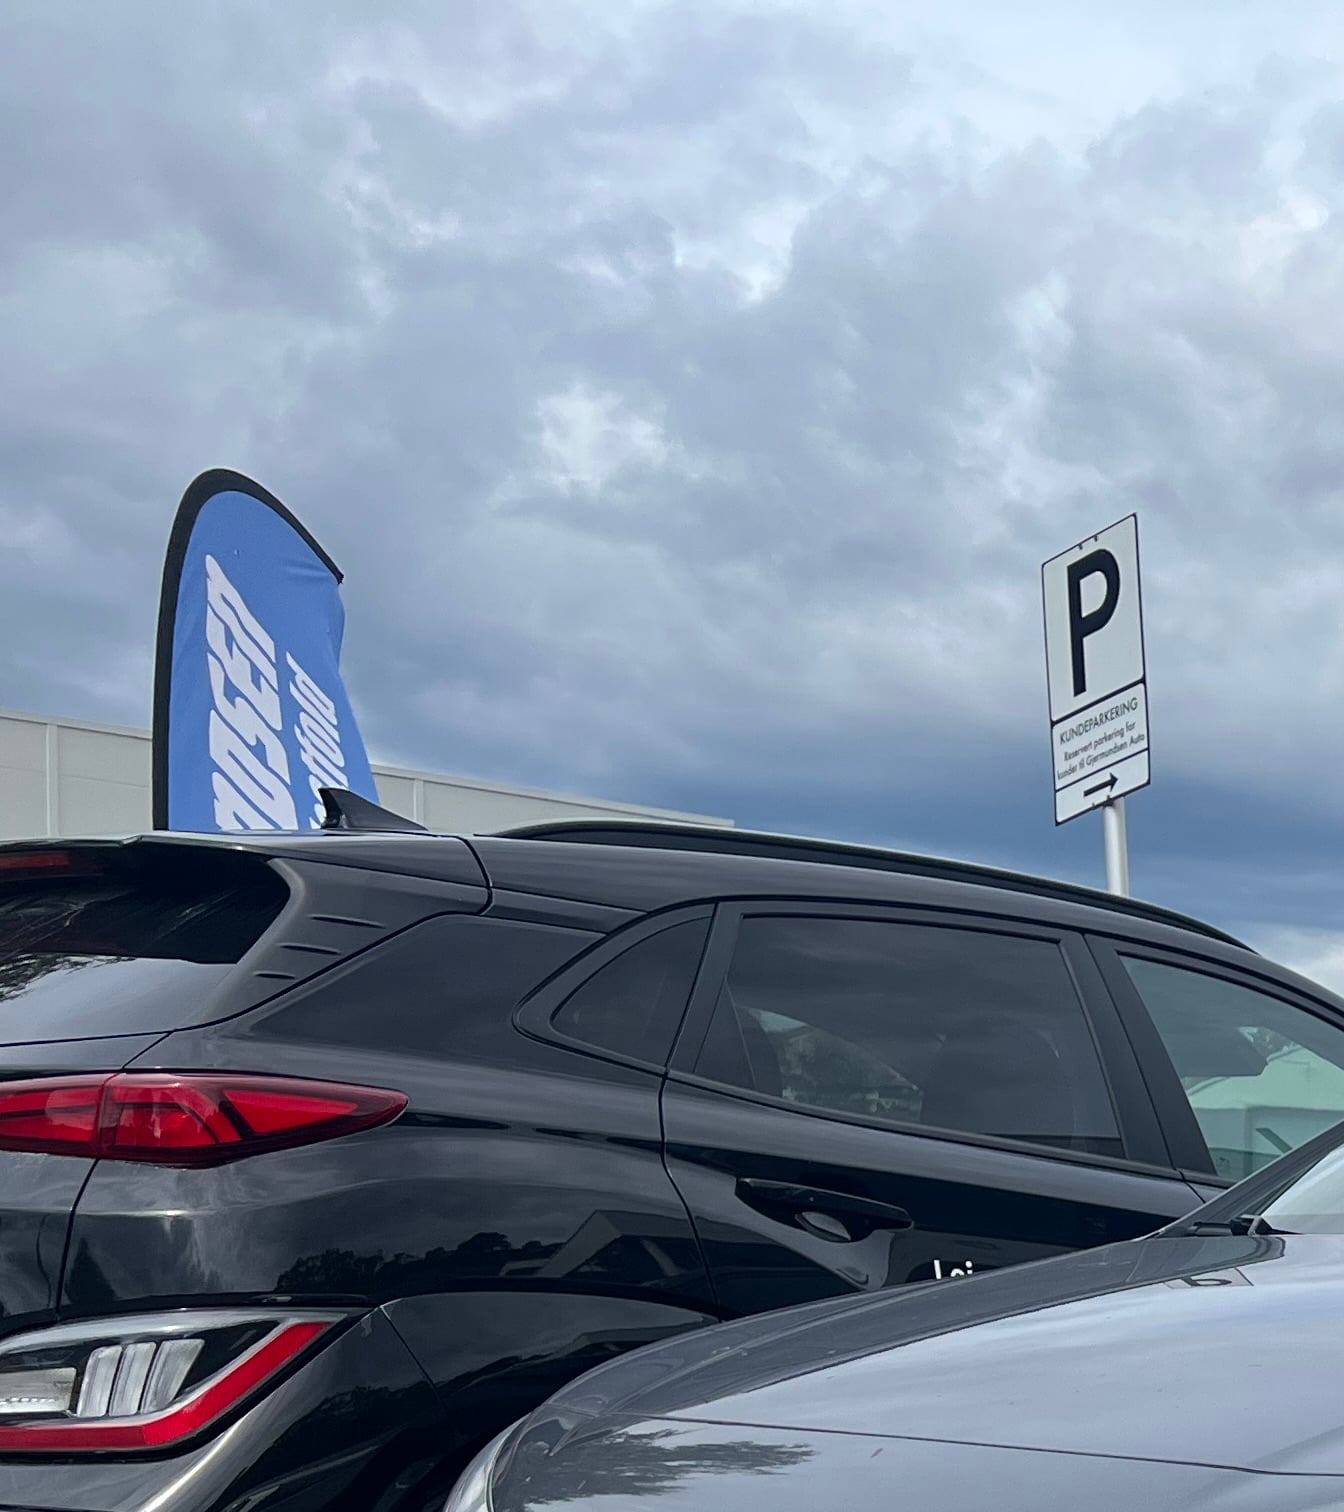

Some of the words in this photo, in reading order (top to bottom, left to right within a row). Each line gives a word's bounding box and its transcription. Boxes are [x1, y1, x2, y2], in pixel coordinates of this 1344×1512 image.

[1067, 548, 1120, 698] P
[1060, 697, 1138, 745] KUNDEPARKERING
[1094, 728, 1125, 750] parkering
[1126, 721, 1136, 732] for
[1057, 763, 1078, 780] kunder
[1129, 734, 1145, 747] Auto
